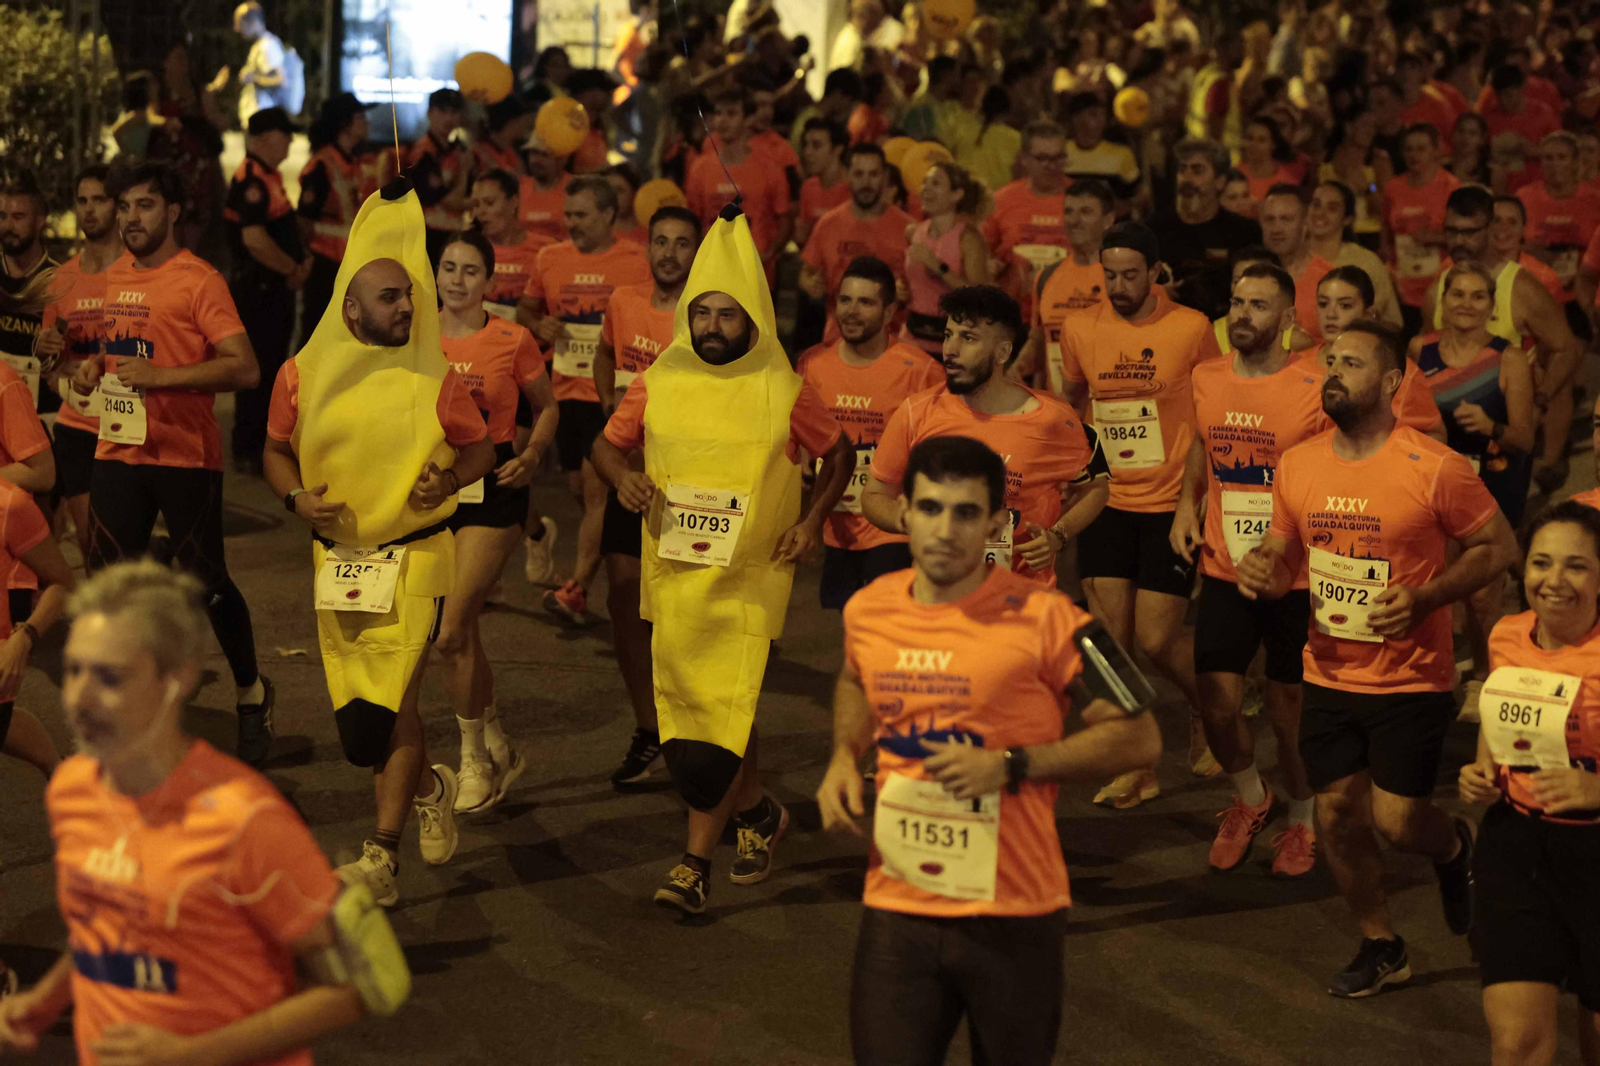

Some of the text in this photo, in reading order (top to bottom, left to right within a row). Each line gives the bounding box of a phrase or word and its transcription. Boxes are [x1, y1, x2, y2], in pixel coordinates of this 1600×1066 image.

[116, 291, 146, 304] XXXV
[633, 334, 662, 356] XXXV
[1098, 371, 1156, 381] SEVILLA KH7
[1114, 363, 1157, 372] NOCTURNA
[104, 397, 134, 415] 21403
[835, 393, 872, 410] XXXV
[1224, 411, 1264, 428] XXXV
[1103, 425, 1148, 441] 19842
[1208, 425, 1276, 439] CARRERA NOCTURNA
[1212, 432, 1276, 447] GUADALQUIVIR
[1325, 495, 1369, 514] XXXV
[678, 511, 731, 534] 10793
[1307, 512, 1382, 524] CARRERA NOCTURNA
[1311, 519, 1381, 533] GUADALQUIVIR
[1318, 580, 1369, 606] 19072
[894, 648, 954, 672] XXXV
[1499, 701, 1542, 728] 8961
[897, 817, 970, 850] 11531
